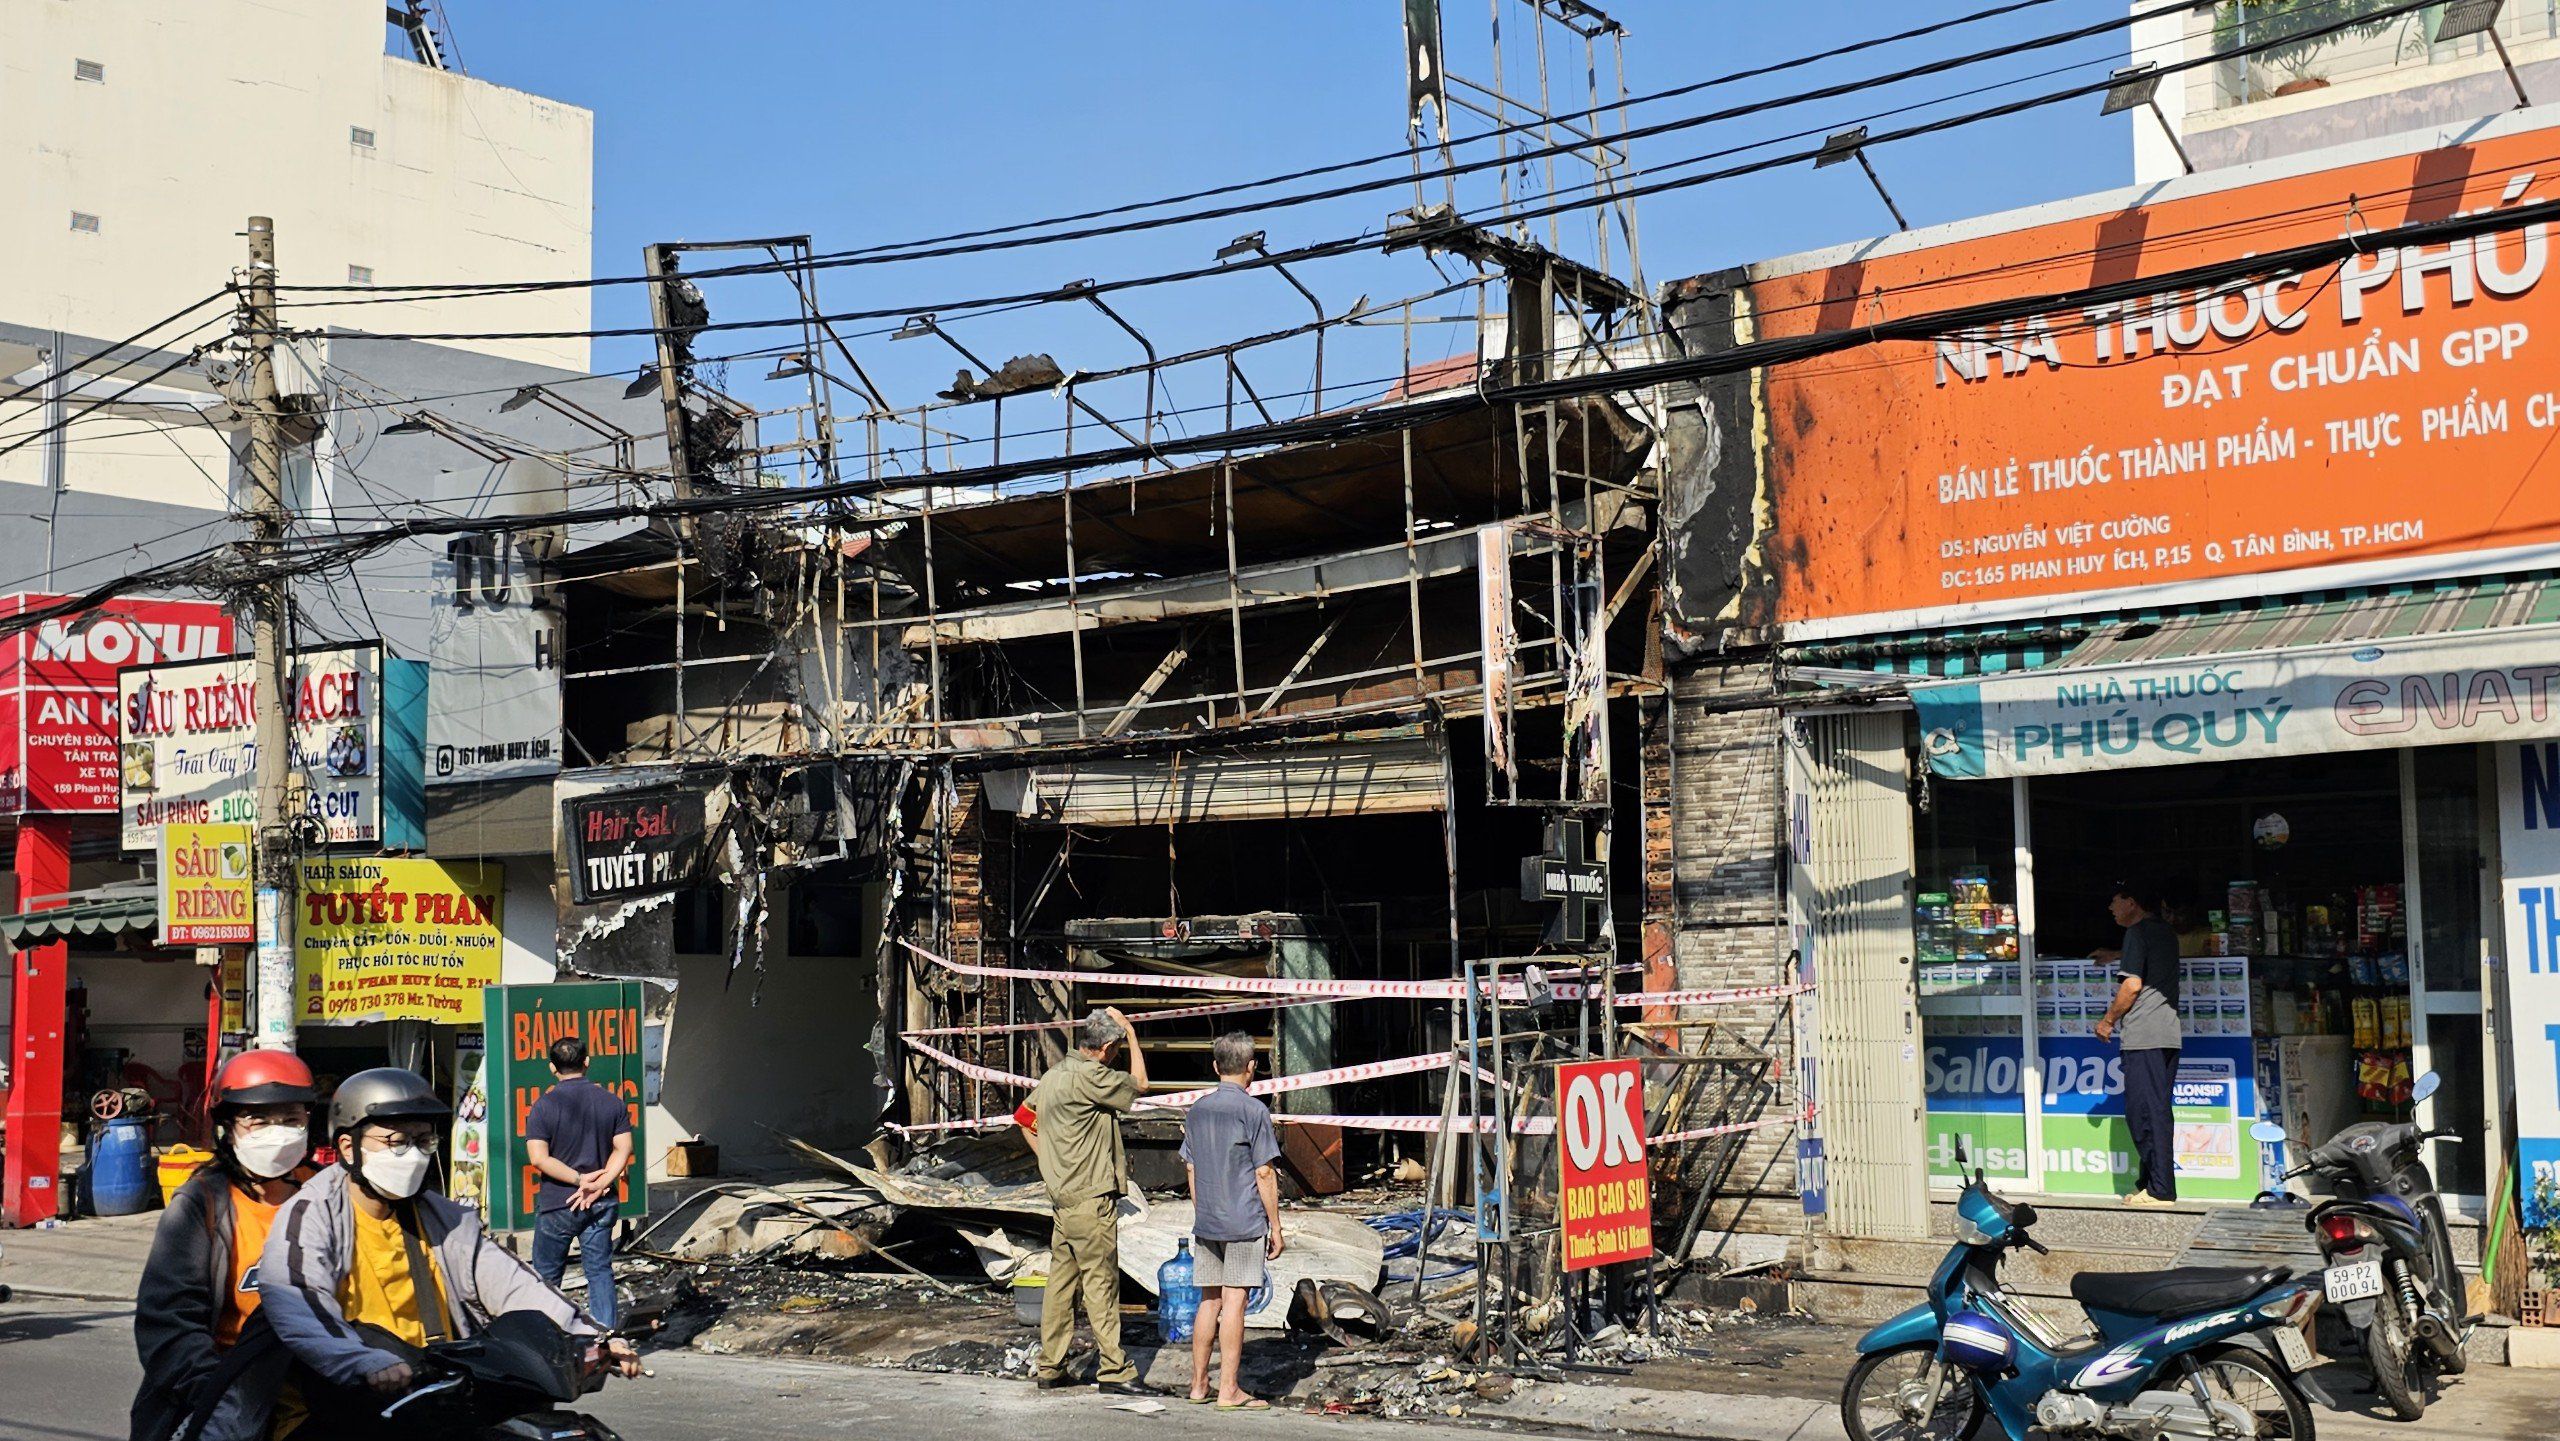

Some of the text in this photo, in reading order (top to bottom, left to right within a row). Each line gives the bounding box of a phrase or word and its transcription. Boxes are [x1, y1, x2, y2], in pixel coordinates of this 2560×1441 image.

[2338, 172, 2548, 321] PHÚ
[2162, 323, 2528, 411] ĐẠT CHUẨN GPP
[1939, 465, 1987, 504] BÁN
[1994, 457, 2019, 497] LẺ
[2029, 444, 2111, 492] THUỐC
[2119, 438, 2206, 480] THÀNH
[2217, 417, 2295, 468] PHẨM
[2325, 412, 2401, 458] THỰC
[2422, 387, 2508, 442] PHẨM
[1974, 522, 2046, 554] NGUYỄN
[2055, 523, 2095, 548] VIỆT
[2100, 512, 2171, 538] CƯỜNG
[2012, 560, 2061, 581] PHAN
[2067, 554, 2105, 575] HUY
[2113, 548, 2148, 571] ÍCH,
[2232, 533, 2275, 558] TÂN
[2283, 527, 2335, 554] BÌNH,
[2340, 519, 2424, 546] TP.HCM
[32, 617, 228, 664] MOTUL
[288, 672, 366, 733] ẠCH
[2057, 676, 2126, 709] NHÀ
[2129, 664, 2243, 701] THUỐC
[38, 696, 89, 725] AN
[29, 733, 81, 746] CHUYÊN
[2014, 696, 2293, 762] PHÚ QUÝ
[64, 748, 89, 762] TÂN
[174, 749, 203, 776] Trái
[208, 747, 237, 778] Cây
[458, 747, 475, 765] 161
[478, 743, 505, 763] PHAN
[507, 741, 528, 760] HUY
[74, 783, 100, 792] Phan
[80, 767, 95, 778] XE
[137, 793, 163, 826] SẦU
[168, 794, 210, 824] RIÊNG
[325, 791, 360, 824] CỤT
[588, 809, 629, 842] Hair
[175, 832, 219, 878] SẦU
[304, 865, 381, 880] HAIR SALON
[587, 840, 646, 891] TUYẾT
[1546, 869, 1603, 893] NHÀ THUỐC
[176, 881, 247, 920] RIÊNG
[306, 877, 496, 926] TUYẾT PHAN
[172, 926, 189, 940] ĐT:
[386, 928, 410, 946] UỐN
[456, 932, 495, 950] NHUỘM
[338, 955, 370, 972] PHỤC
[397, 952, 420, 965] TÓC
[329, 980, 353, 991] 161
[358, 974, 398, 989] PHAN
[401, 975, 432, 986] HUY
[434, 973, 463, 989] ÍCH,
[329, 999, 357, 1013] 0978
[361, 995, 381, 1010] 730
[384, 992, 404, 1009] 378
[407, 993, 424, 1006] Mr.
[514, 997, 637, 1061] BÁNH KEM
[1565, 1071, 1643, 1171] OK
[1567, 1178, 1646, 1221] BAO CAO SU
[1569, 1225, 1649, 1260] Thuốc Sinh Lý Nam
[2333, 1265, 2371, 1284] 59-P2
